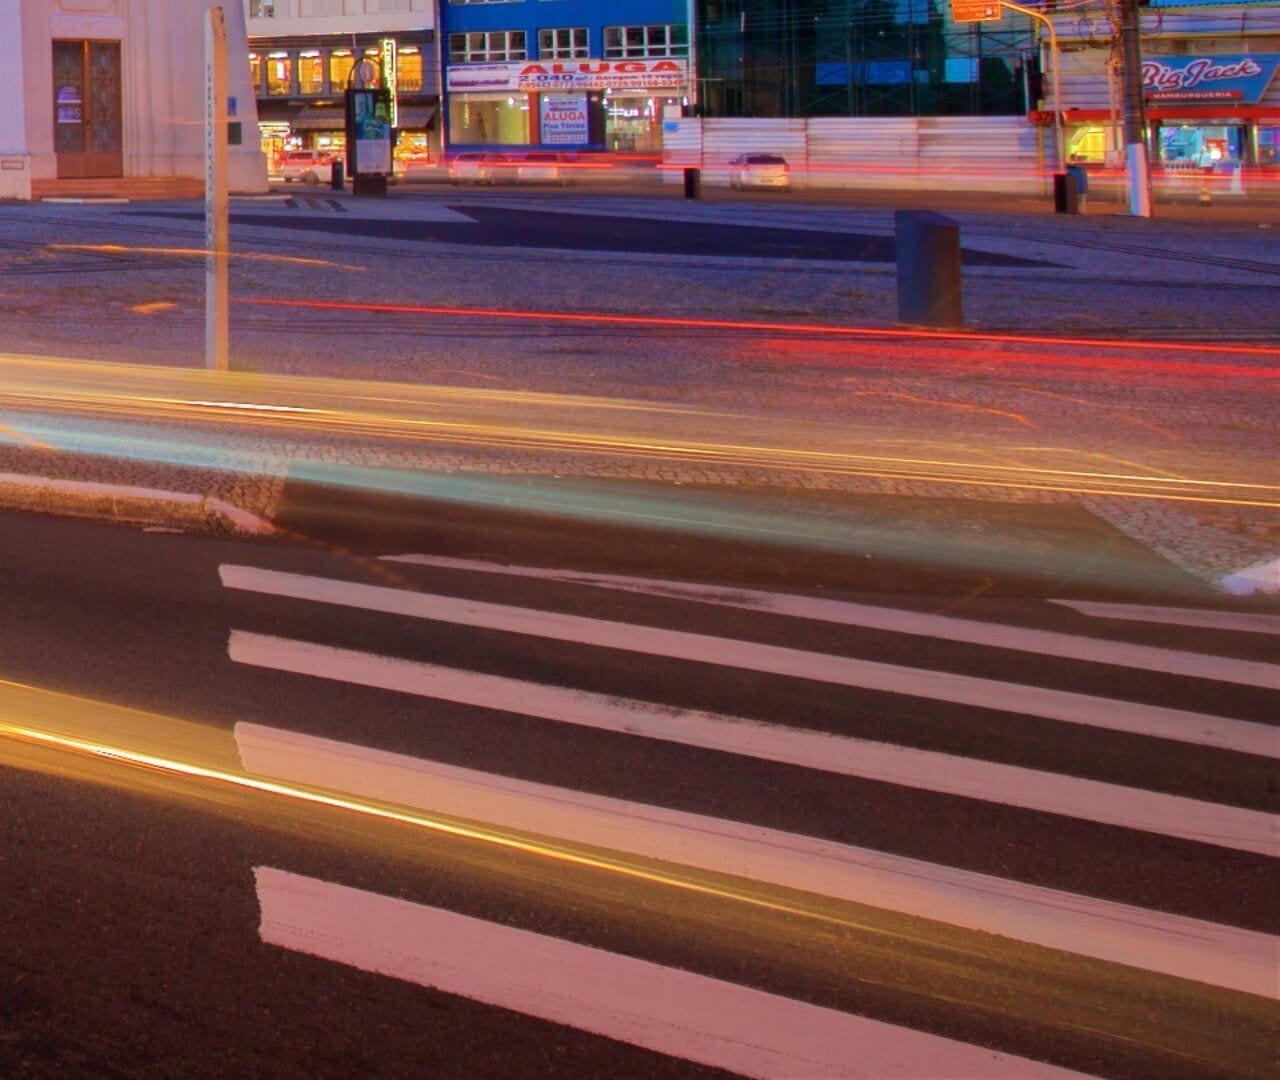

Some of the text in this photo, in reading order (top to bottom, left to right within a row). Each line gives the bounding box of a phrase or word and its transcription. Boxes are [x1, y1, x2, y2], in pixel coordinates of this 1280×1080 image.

[520, 61, 680, 74] ALUGA
[1142, 58, 1262, 90] Big Jack
[1153, 91, 1232, 100] HAMBURGUERIA
[544, 111, 586, 121] ALUGA
